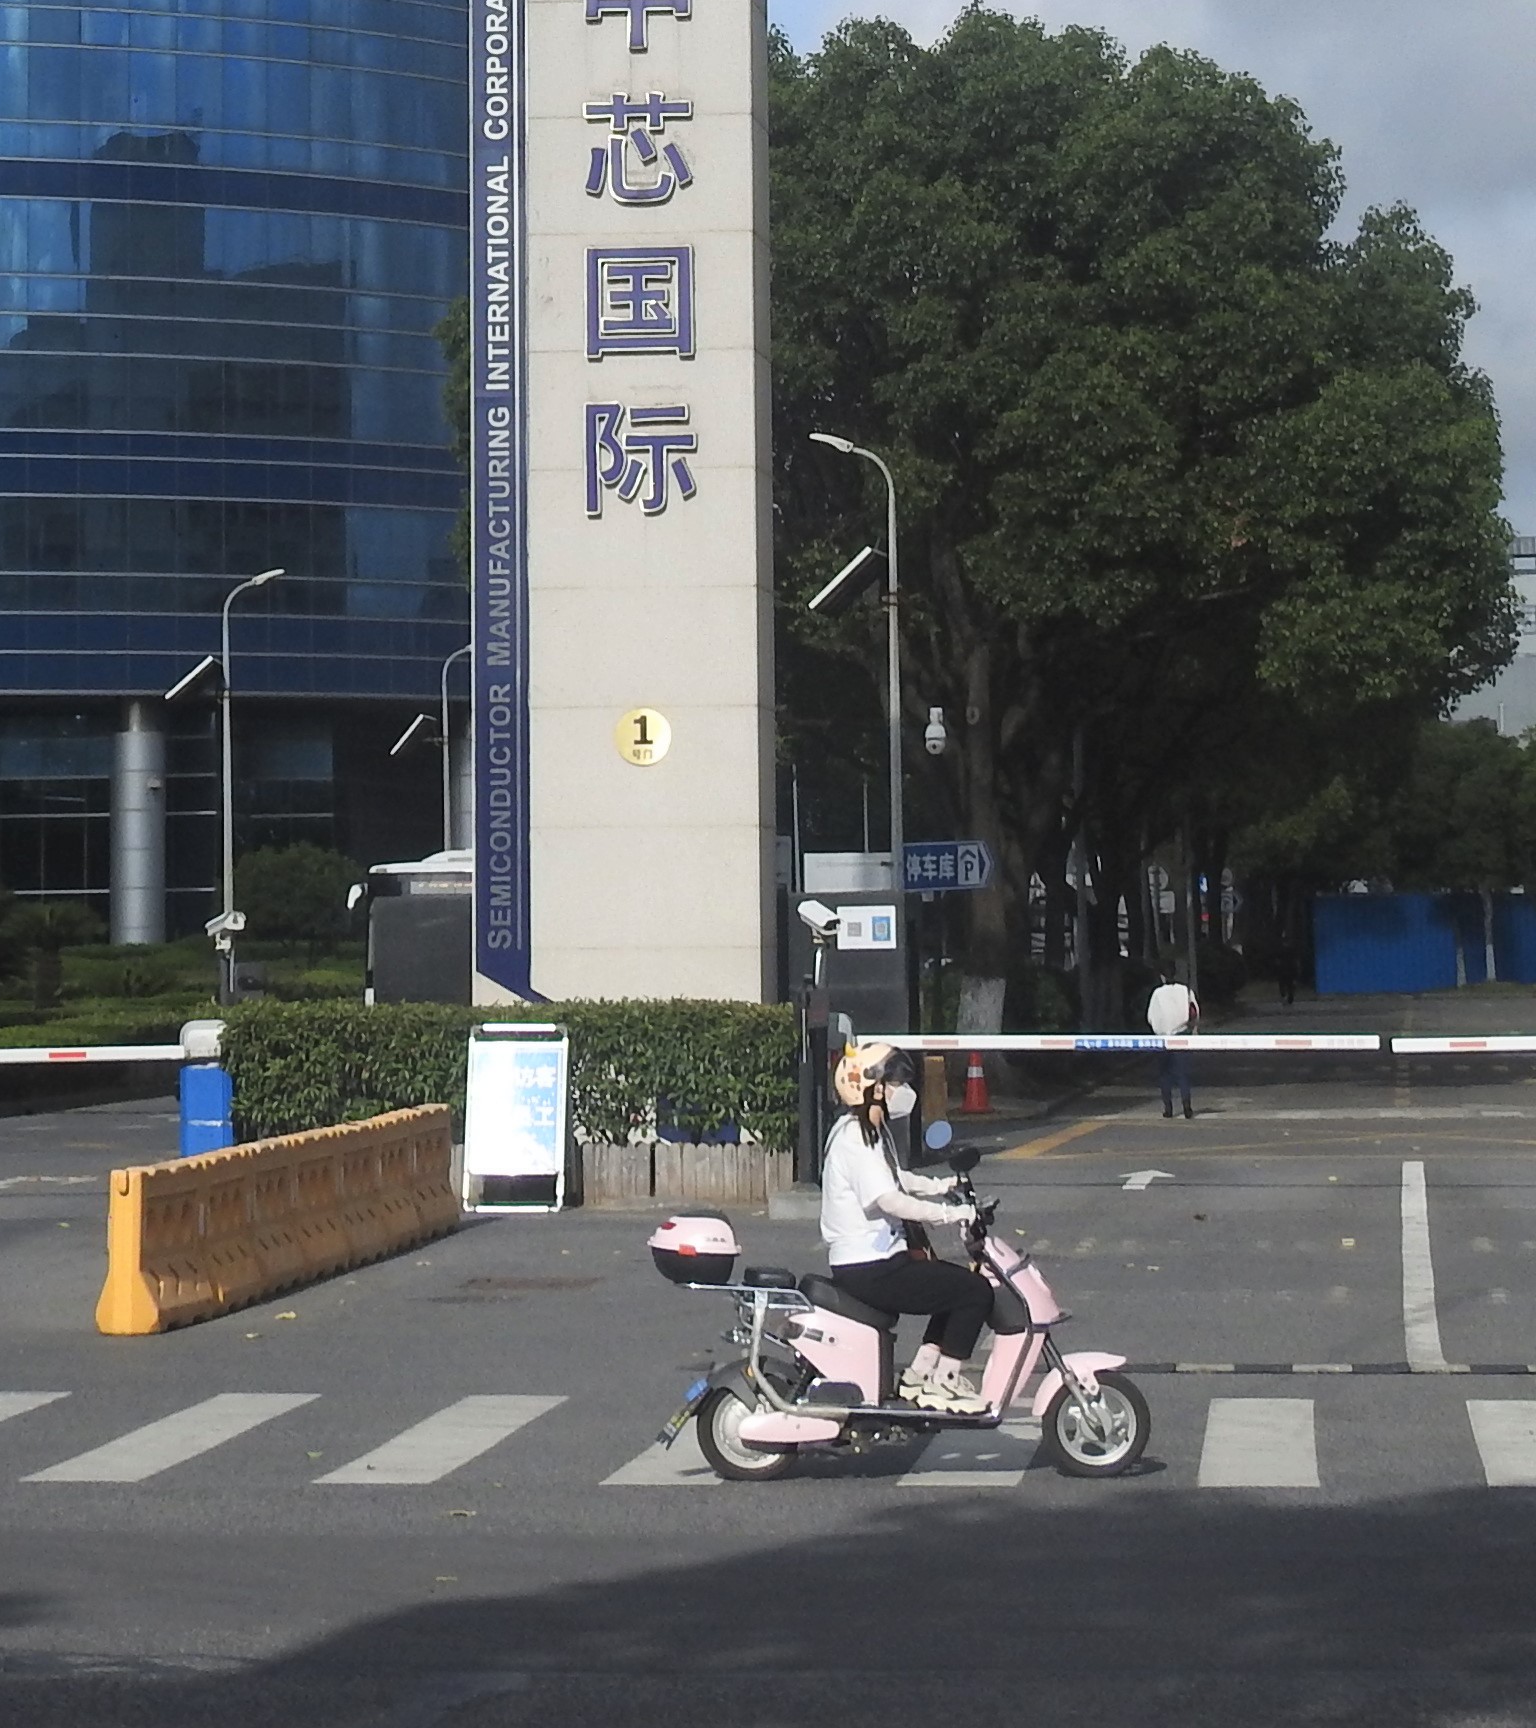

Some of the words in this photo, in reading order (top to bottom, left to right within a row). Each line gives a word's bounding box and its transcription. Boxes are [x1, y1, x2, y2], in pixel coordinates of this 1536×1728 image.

[485, 156, 510, 390] INTERNATIONAL
[486, 406, 511, 666] MANUFACTURING
[487, 683, 512, 950] SEMICONDUCTOR
[633, 715, 654, 745] 1
[906, 852, 955, 883] 停车库
